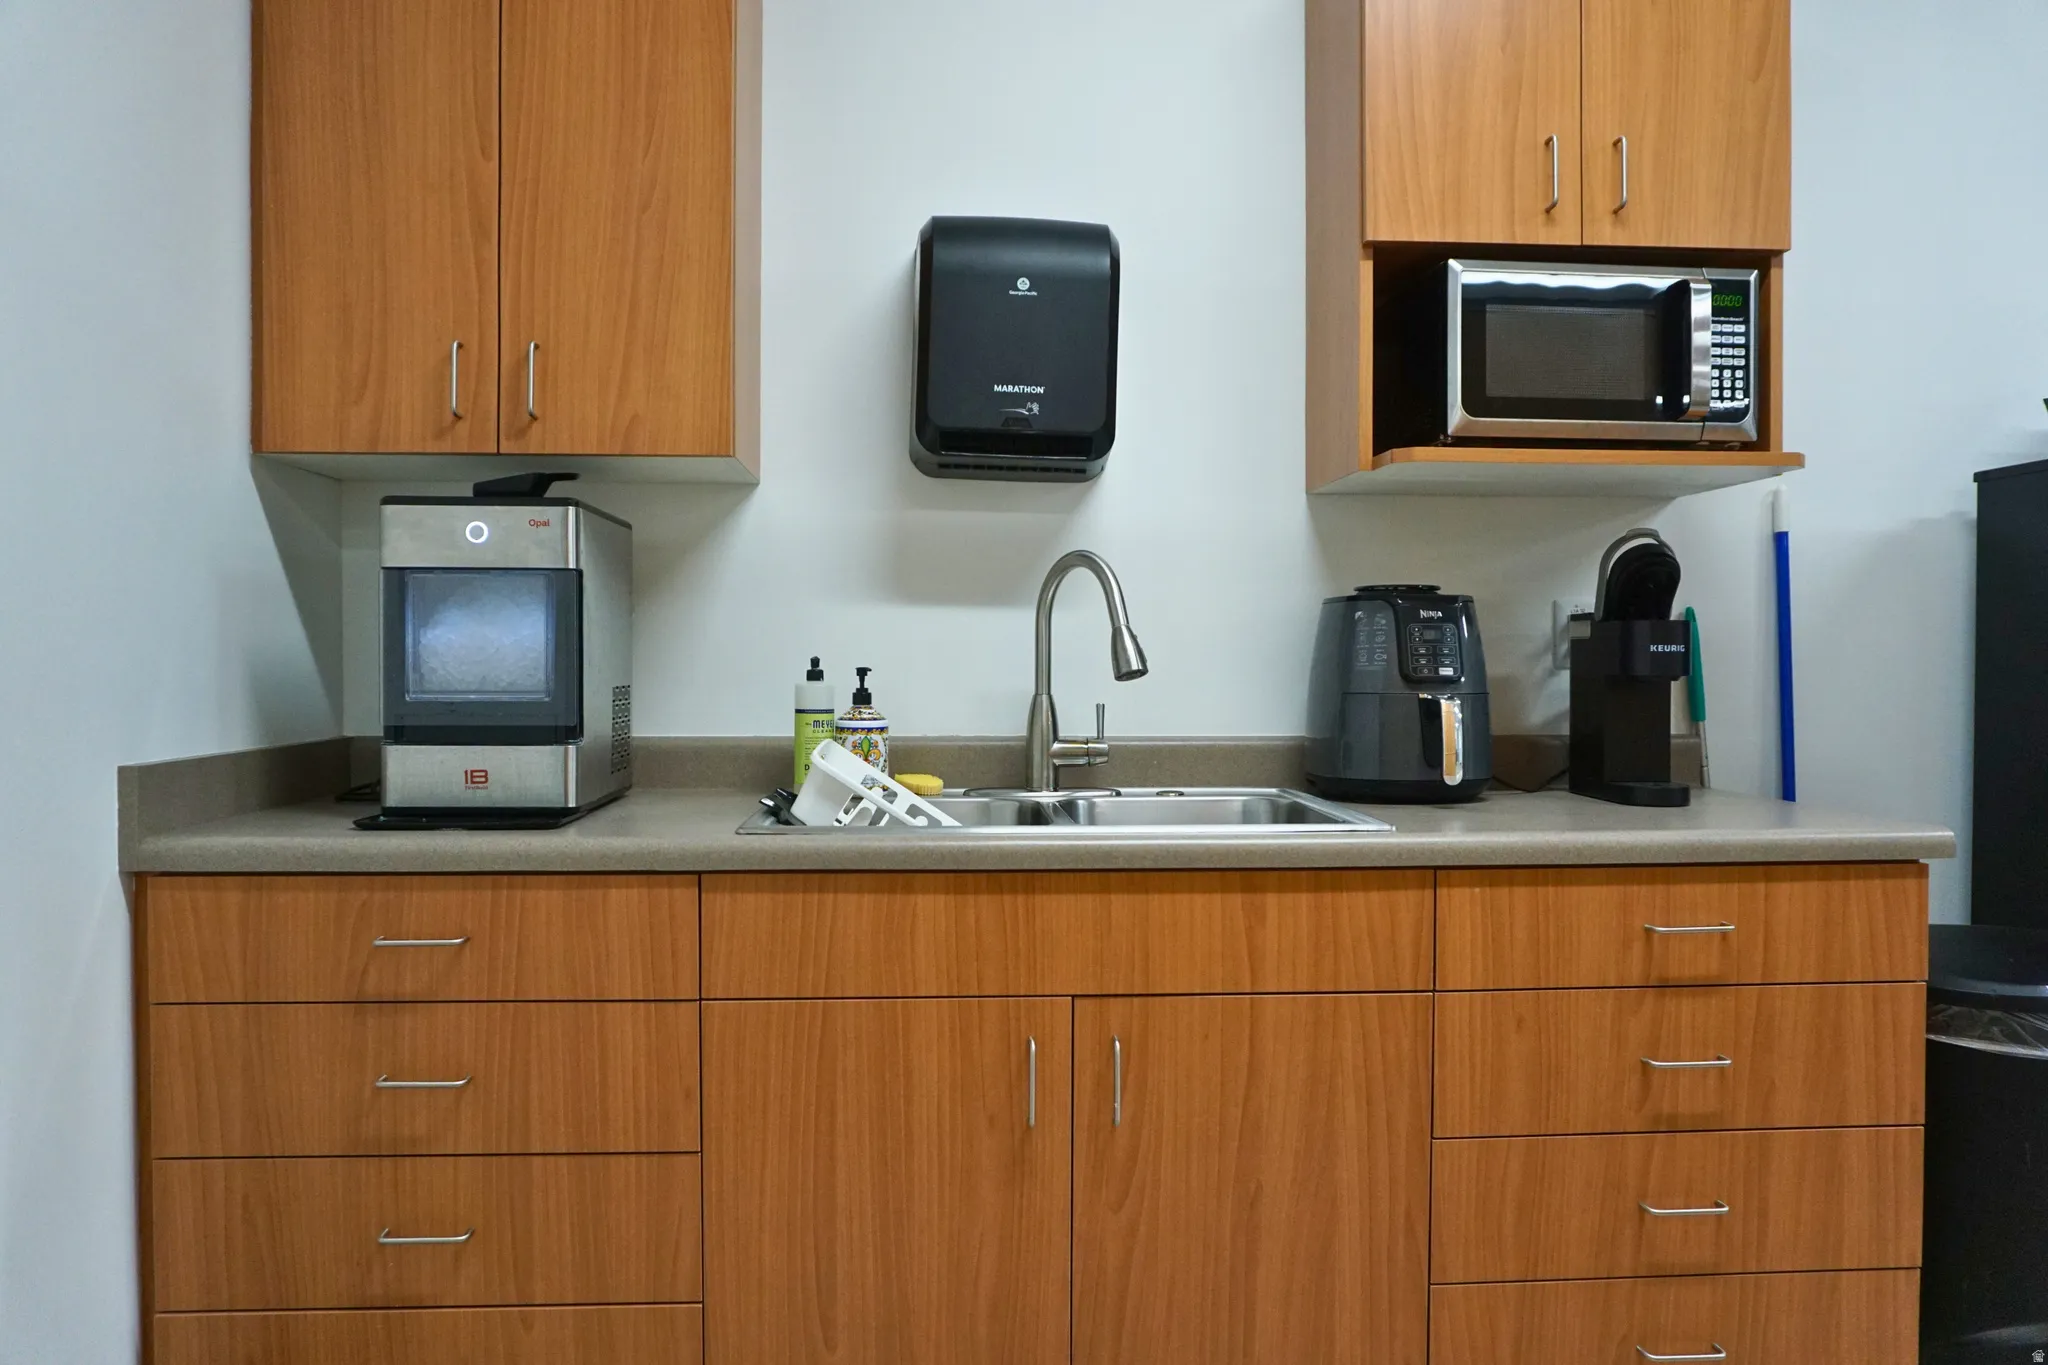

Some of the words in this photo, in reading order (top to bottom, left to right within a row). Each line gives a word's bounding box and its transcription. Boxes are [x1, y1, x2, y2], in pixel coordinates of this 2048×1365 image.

[993, 384, 1044, 394] MARATHON
[528, 518, 550, 528] Opal
[1650, 644, 1685, 652] KEURIG
